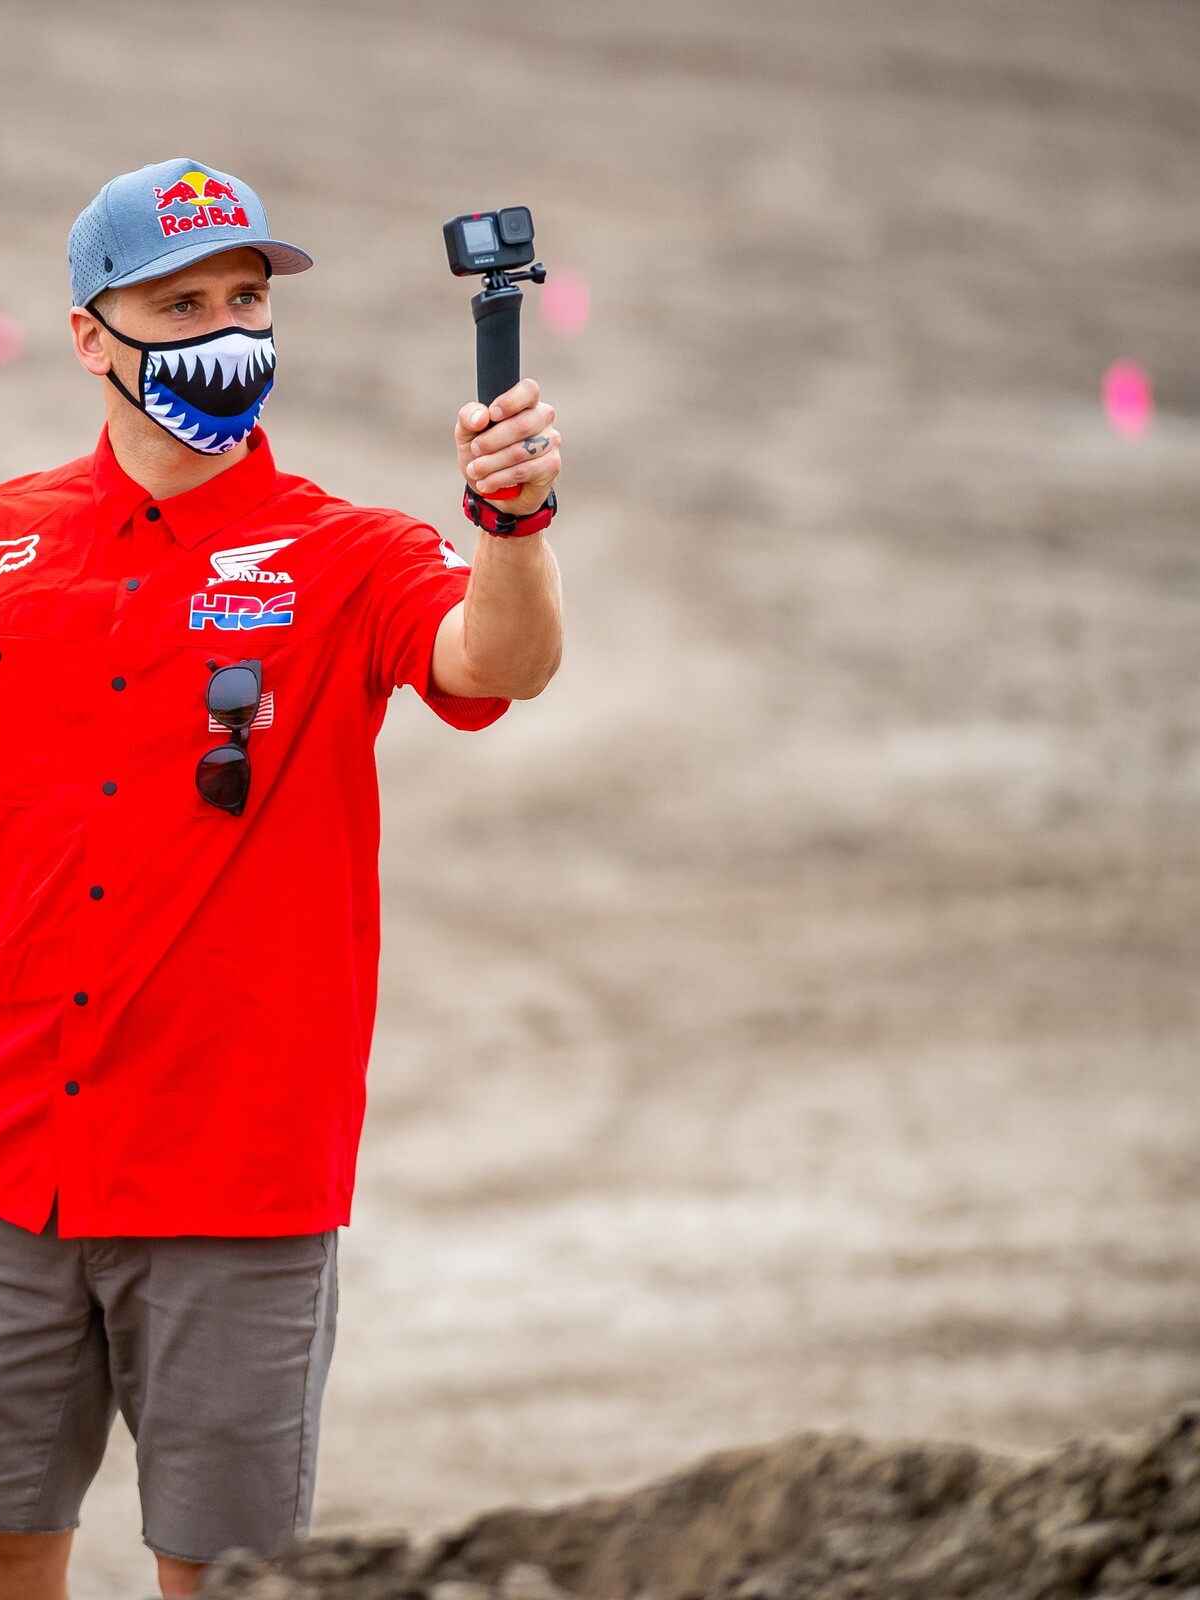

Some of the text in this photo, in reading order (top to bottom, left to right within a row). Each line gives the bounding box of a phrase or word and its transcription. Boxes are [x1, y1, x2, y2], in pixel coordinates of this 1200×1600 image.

[158, 206, 251, 237] Red Bull
[189, 592, 296, 630] HRC
